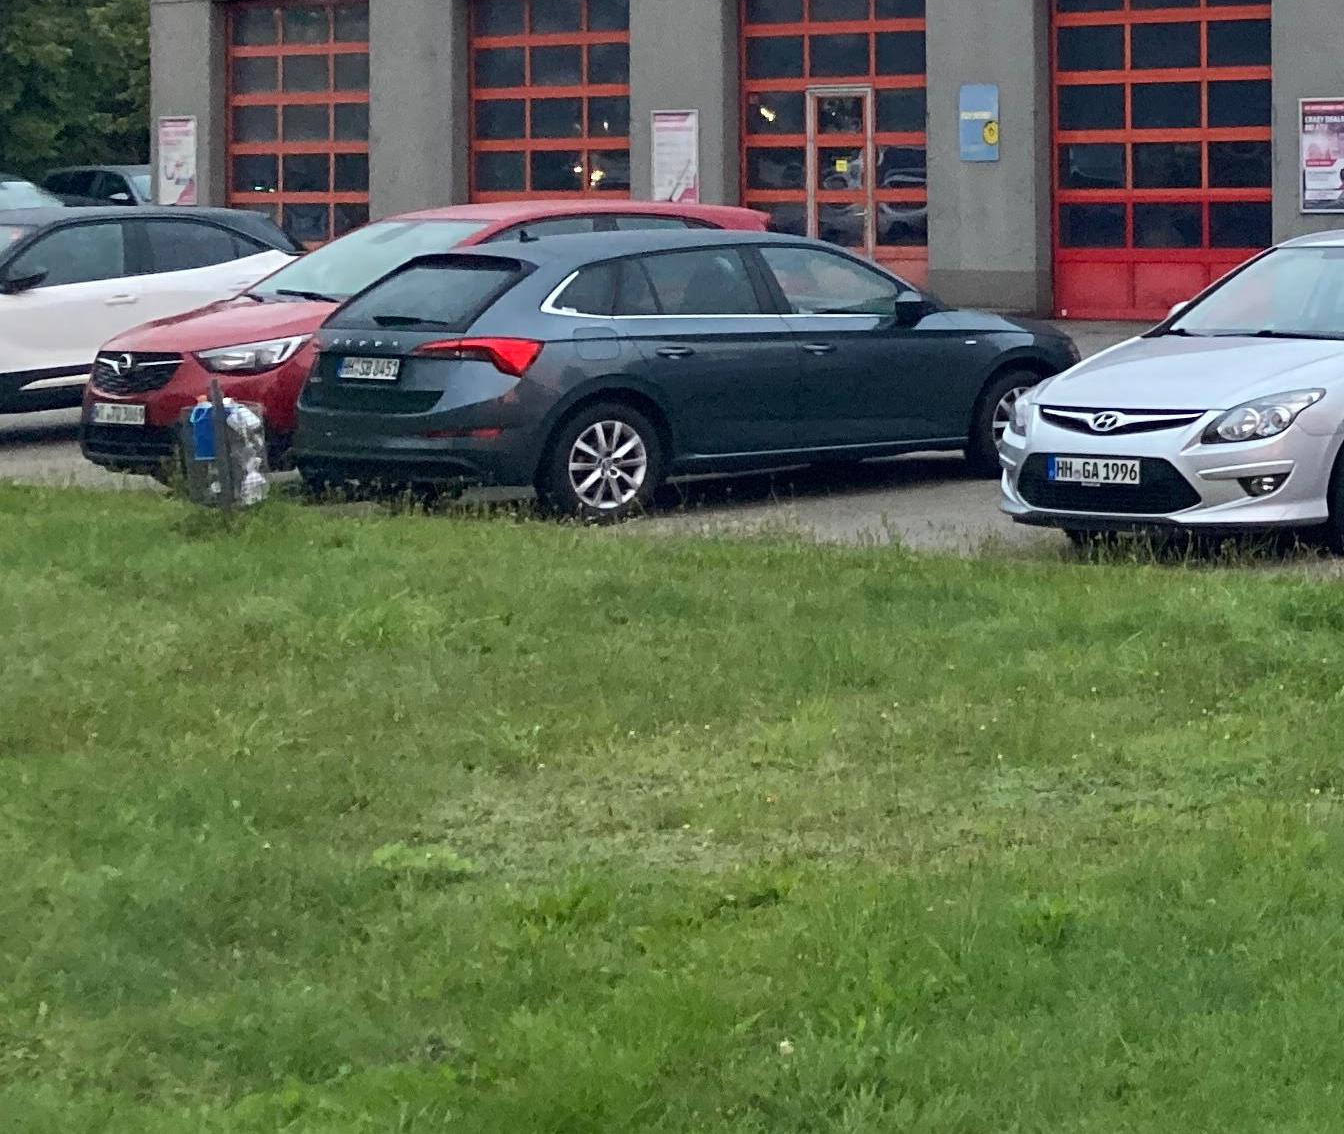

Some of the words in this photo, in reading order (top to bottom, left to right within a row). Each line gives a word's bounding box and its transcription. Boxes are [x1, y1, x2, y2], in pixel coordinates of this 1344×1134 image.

[1056, 461, 1072, 478] HH
[1082, 462, 1099, 479] GA
[1103, 463, 1137, 481] 1996
